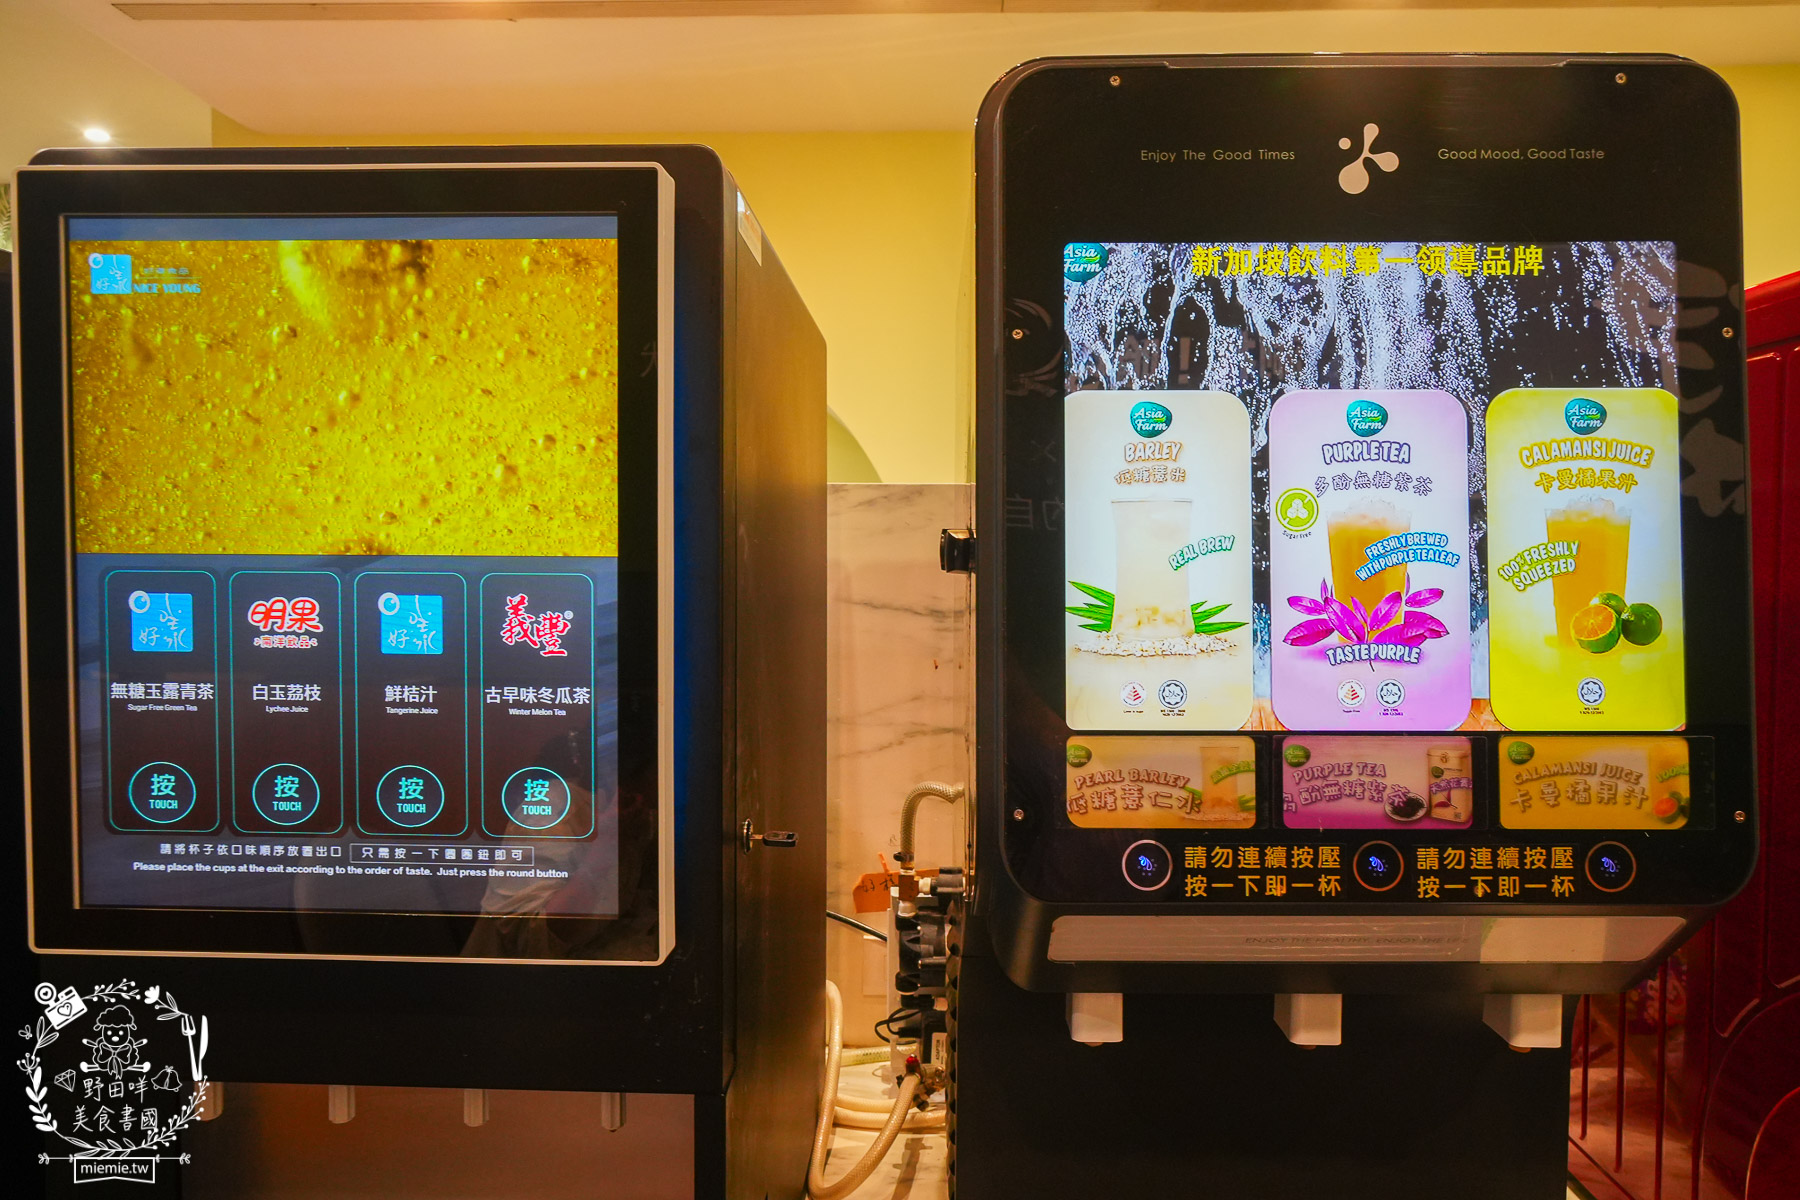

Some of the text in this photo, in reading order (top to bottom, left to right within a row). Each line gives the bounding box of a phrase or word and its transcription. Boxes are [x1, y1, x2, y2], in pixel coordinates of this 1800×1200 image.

[1141, 149, 1296, 163] Enjoy The Good Times
[1437, 148, 1605, 161] Good Mood, Good Taste
[1064, 244, 1098, 258] Asia
[1064, 258, 1102, 273] Farm
[162, 283, 201, 294] YOUNG
[1133, 407, 1164, 419] Asia
[1348, 406, 1379, 418] Asia
[1567, 404, 1598, 415] Asia
[1135, 418, 1168, 431] Farm
[1351, 417, 1383, 430] Farm
[1570, 415, 1602, 428] Farm
[1124, 441, 1183, 463] BARLEY
[1322, 440, 1411, 465] PURPLE TEA
[1519, 438, 1655, 468] CALAMANSI JUICE
[1315, 470, 1433, 498] 多酚無糖紫茶
[1535, 467, 1638, 493] 卡曼橘果汁
[1168, 535, 1235, 571] REAL BREW
[1365, 532, 1449, 560] FRESHLY BREWED
[1522, 541, 1579, 566] FRESHLY
[1355, 548, 1460, 581] WITH PURPLE TEA LEAF
[1512, 558, 1576, 591] SQUEEZED
[248, 597, 323, 632] 明果
[500, 593, 572, 657] 義豐
[1326, 643, 1421, 666] TASTE PURPLE
[110, 682, 215, 701] 無糖玉露青茶
[252, 683, 322, 702] 白玉荔枝
[384, 685, 438, 703] 鮮桔汁
[485, 686, 591, 705] 古早味冬瓜茶
[128, 704, 148, 712] Sugar
[265, 705, 290, 713] Lychee
[385, 706, 420, 715] Tangerine
[531, 708, 553, 716] Melon
[1074, 768, 1124, 790] PEARL
[1127, 768, 1190, 788] BARLEY
[1293, 762, 1387, 785] PURPLE TEA
[1513, 761, 1643, 785] CALAMANSI JUICE
[151, 774, 176, 796] 按
[274, 775, 300, 798] 按
[398, 777, 424, 800] 按
[524, 779, 550, 802] 按
[149, 799, 178, 810] TOUCH
[272, 801, 302, 811] TOUCH
[396, 803, 426, 813] TOUCH
[522, 805, 552, 815] TOUCH
[160, 843, 342, 857] 請將杯子依口味順序放置出口
[1184, 846, 1341, 869] 請勿連續按壓
[1416, 846, 1575, 870] 請勿連續按壓
[133, 862, 568, 878] Please place the cups at the exit according to the order of taste. Just press the round button
[1185, 874, 1341, 897] 按一下即一杯
[1417, 875, 1575, 899] 按一下即一杯
